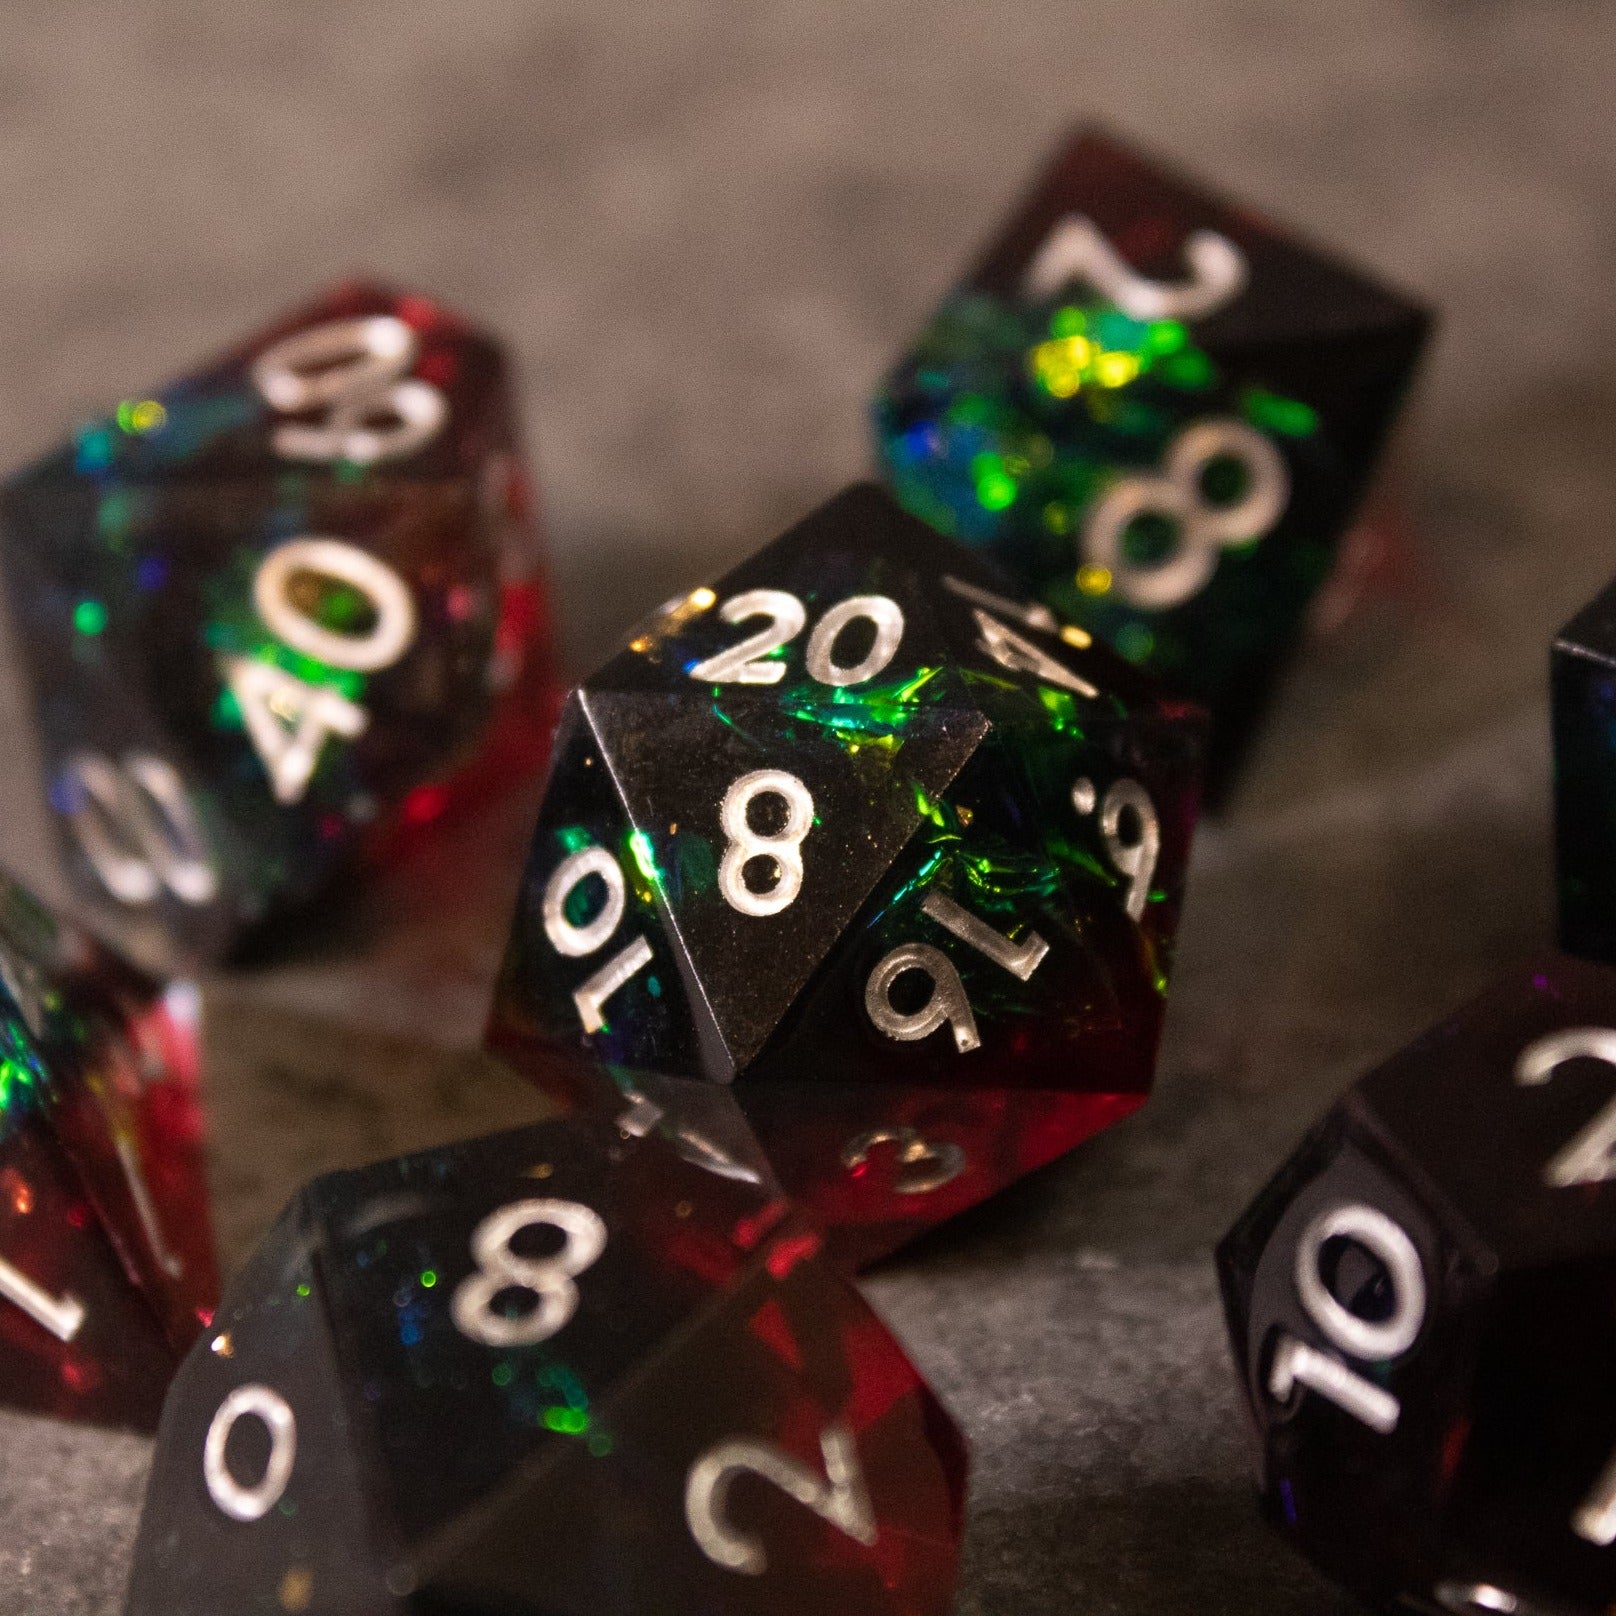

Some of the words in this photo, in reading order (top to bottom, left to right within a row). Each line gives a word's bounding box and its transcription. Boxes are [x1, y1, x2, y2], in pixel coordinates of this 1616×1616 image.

[1022, 215, 1248, 322] 2
[1080, 418, 1291, 610] 8
[224, 536, 418, 803] 40
[688, 588, 906, 686] 20
[717, 768, 815, 917] 8
[542, 845, 655, 1034] 10
[864, 895, 1051, 1055] 16
[450, 1198, 608, 1348] 8
[1268, 1202, 1426, 1434] 10
[203, 1384, 298, 1523] 0
[684, 1426, 878, 1577] 2
